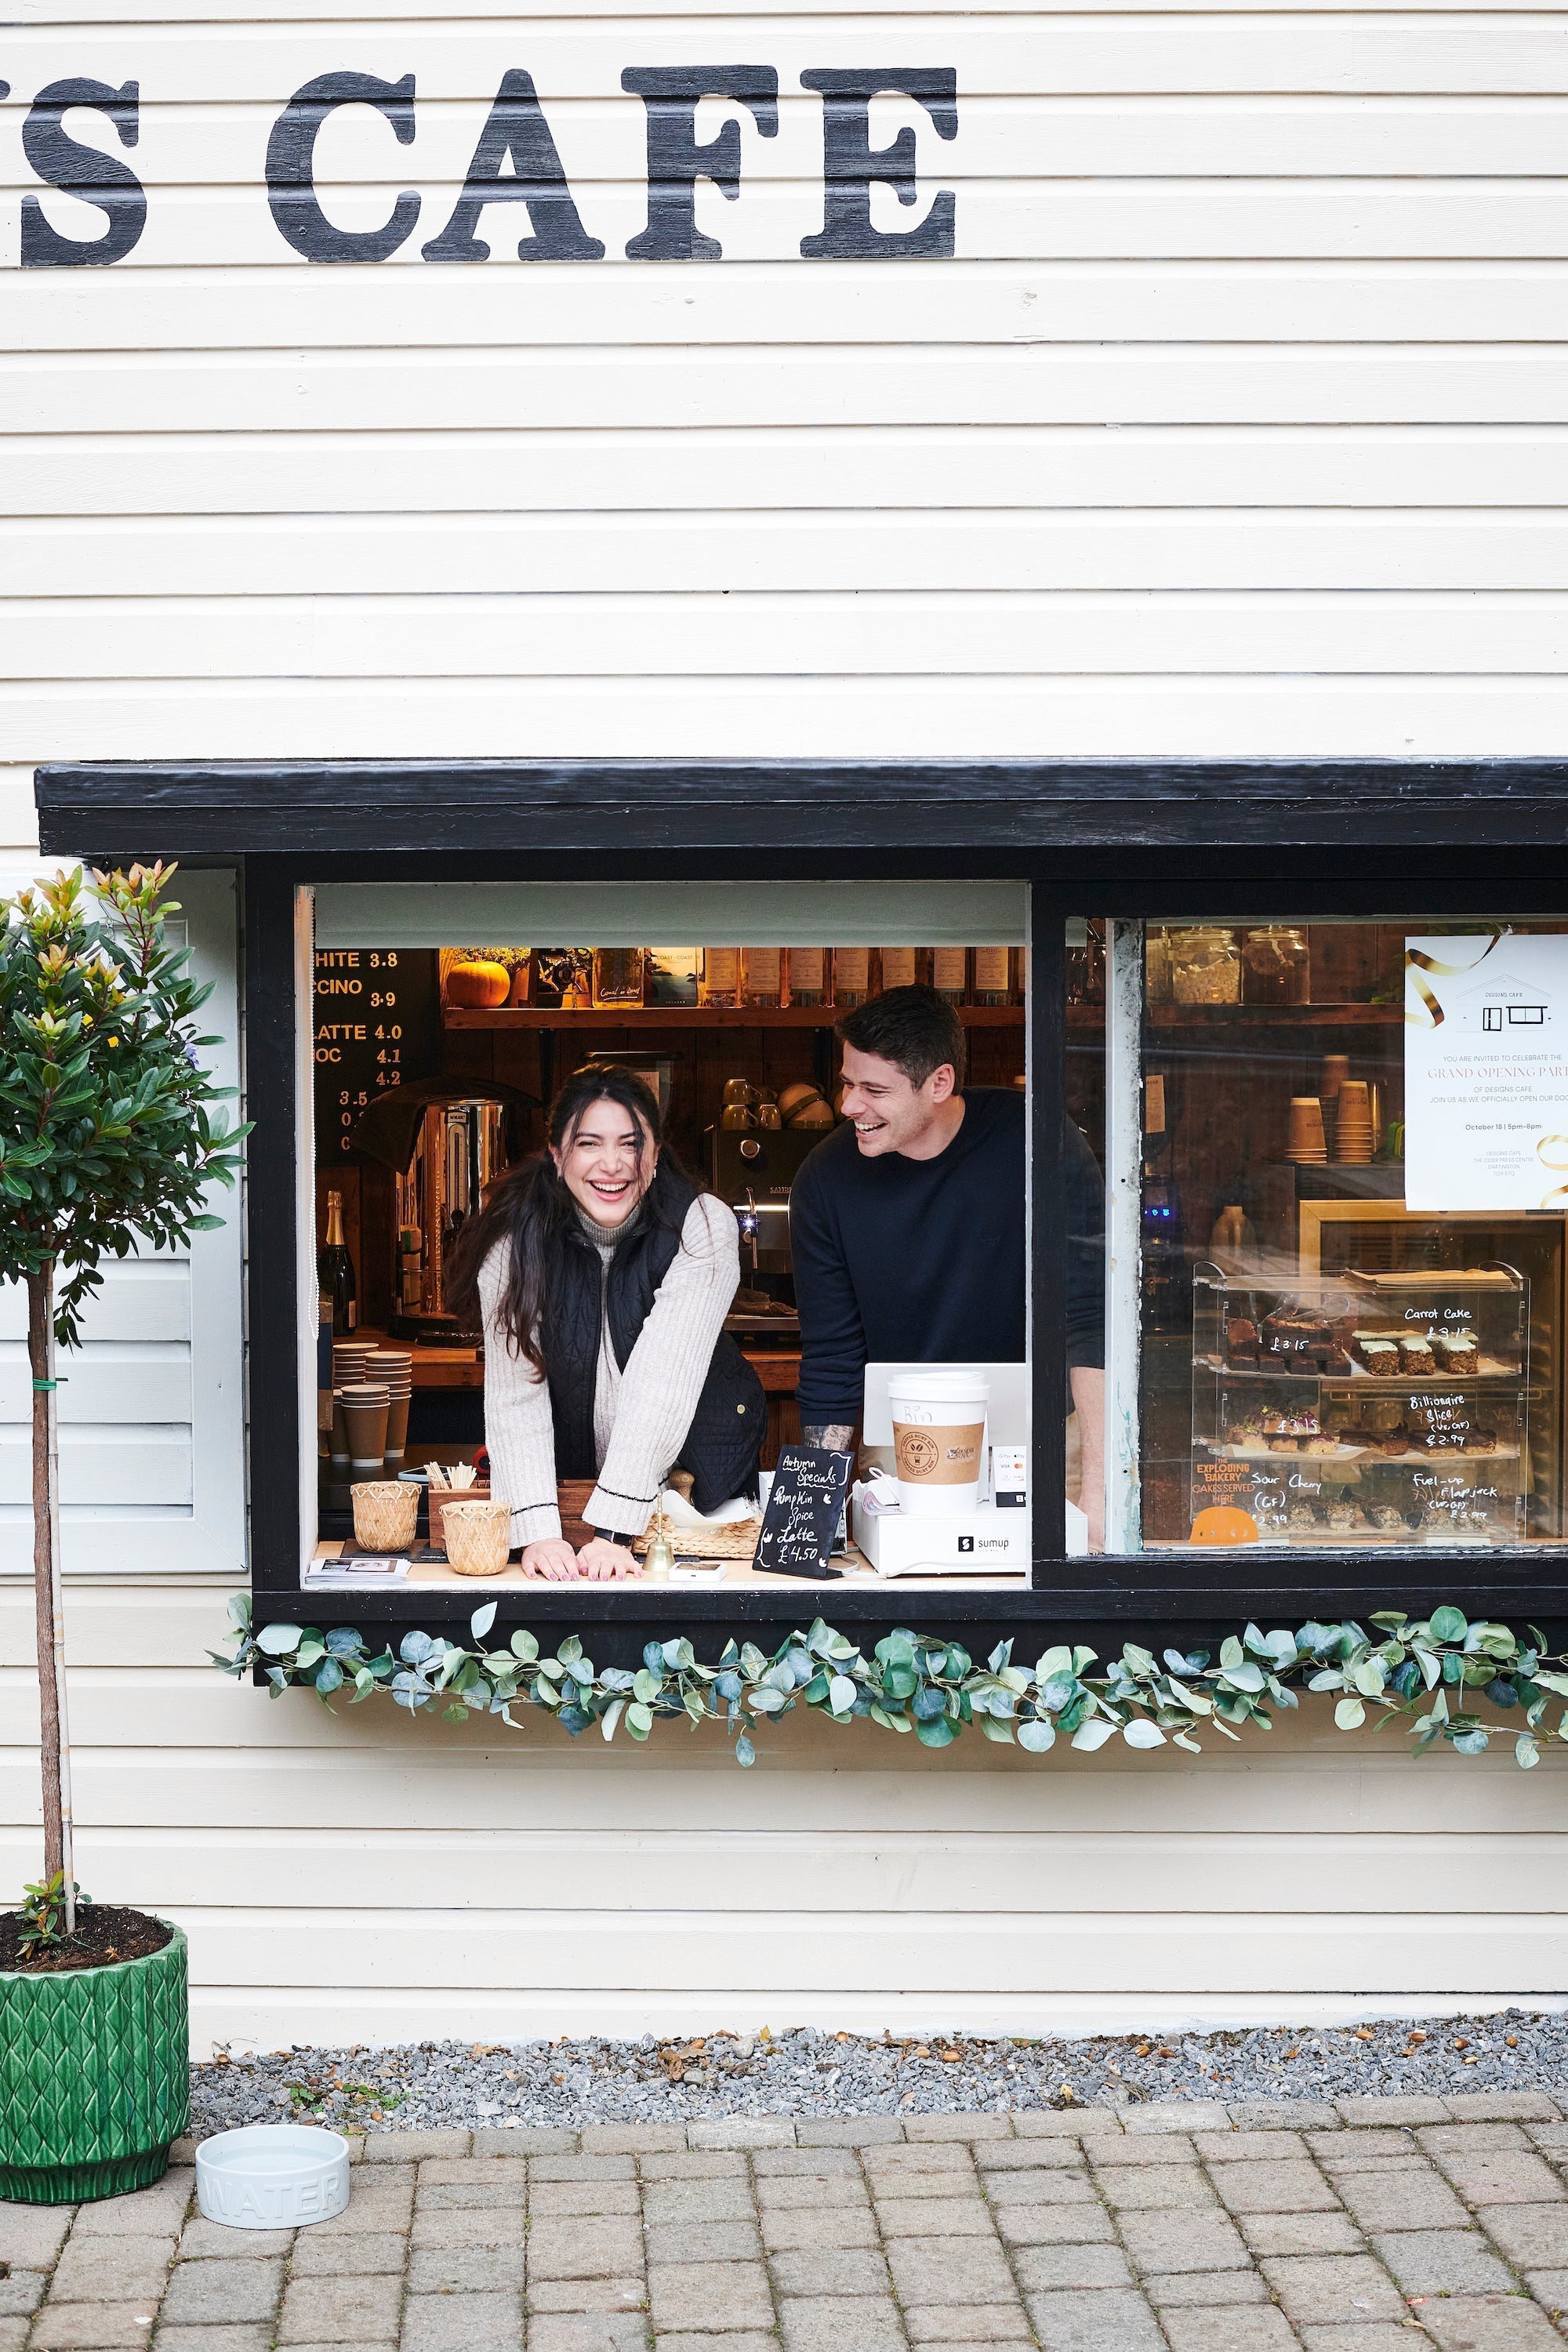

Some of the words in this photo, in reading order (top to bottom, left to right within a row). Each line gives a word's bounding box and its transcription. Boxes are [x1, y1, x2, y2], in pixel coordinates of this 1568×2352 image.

[0, 77, 147, 267] S
[265, 65, 957, 263] CAFE
[315, 952, 360, 967] HITE
[369, 952, 398, 968] 3.8
[370, 992, 396, 1007] 3.9
[314, 1025, 367, 1040] ATTE
[374, 1024, 402, 1040] 4.0
[314, 1047, 342, 1063] OC
[376, 1048, 401, 1064] 4.1
[376, 1071, 401, 1086] 4.2
[1428, 1068, 1474, 1079] GRAND
[1477, 1067, 1536, 1078] OPENING
[339, 1091, 368, 1106] 3.5
[1405, 1308, 1439, 1320] Carrot
[1426, 1327, 1471, 1340] £3.15
[1270, 1337, 1310, 1352] £3.15
[1410, 1393, 1465, 1410] Billionaire
[904, 1406, 932, 1424] Bin
[1427, 1409, 1453, 1422] Slice
[1276, 1417, 1319, 1434] £3.15
[1425, 1434, 1465, 1447] £2.99
[782, 1455, 816, 1468] Autumn
[1196, 1463, 1250, 1473] EXPLODING
[797, 1466, 837, 1485] Specials
[1204, 1472, 1242, 1483] BAKERY
[1251, 1472, 1280, 1484] Sour
[1288, 1474, 1322, 1494] Cherry
[1412, 1473, 1465, 1486] Fuel-up
[1192, 1484, 1223, 1494] CAKES
[1223, 1483, 1255, 1493] SERVED
[1441, 1486, 1497, 1499] Flapjack
[1212, 1494, 1235, 1504] HERE
[1254, 1490, 1287, 1512] (GF)
[788, 1507, 815, 1528] Spice
[1450, 1509, 1487, 1519] £2.99
[777, 1526, 818, 1544] Latte
[978, 1540, 1009, 1551] sumup
[778, 1544, 818, 1564] £4.50
[201, 2172, 341, 2220] WATER
